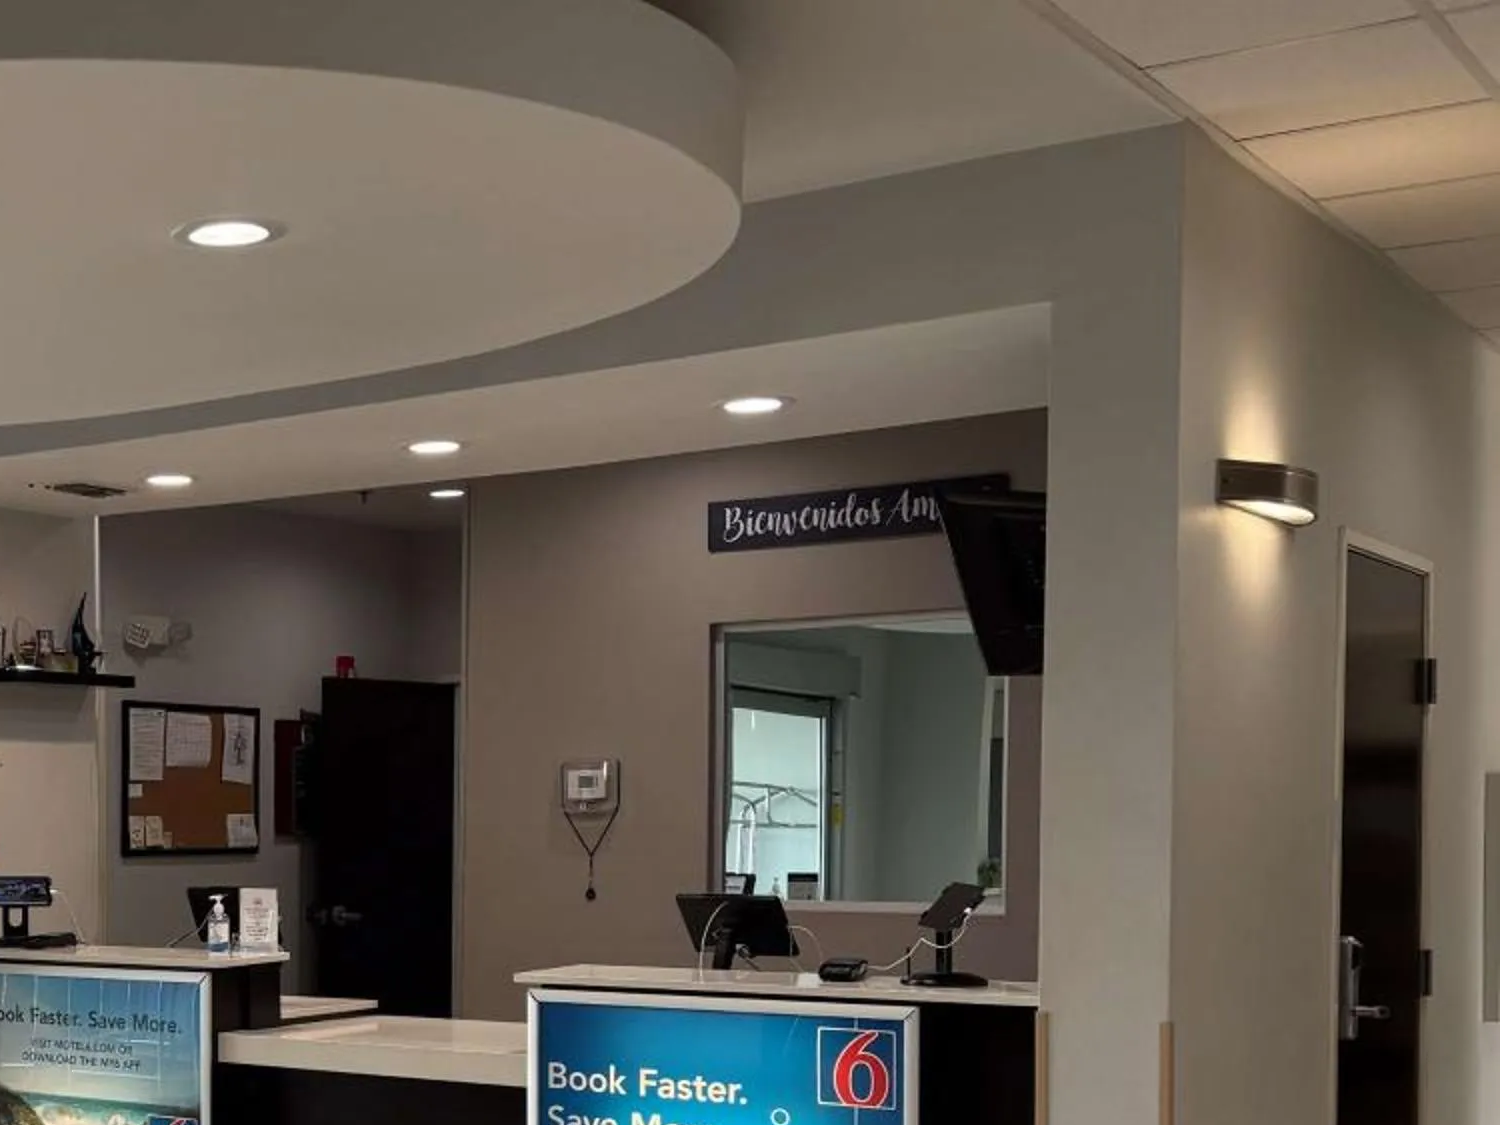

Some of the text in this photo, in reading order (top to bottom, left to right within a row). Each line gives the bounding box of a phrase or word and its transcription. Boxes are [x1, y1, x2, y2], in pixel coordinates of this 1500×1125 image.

[723, 488, 938, 543] Bienvenidos Am
[30, 1007, 82, 1028] Faster.
[88, 1010, 126, 1029] Save
[132, 1013, 182, 1034] More.
[548, 1061, 748, 1105] Book Faster.
[833, 1029, 889, 1109] 6
